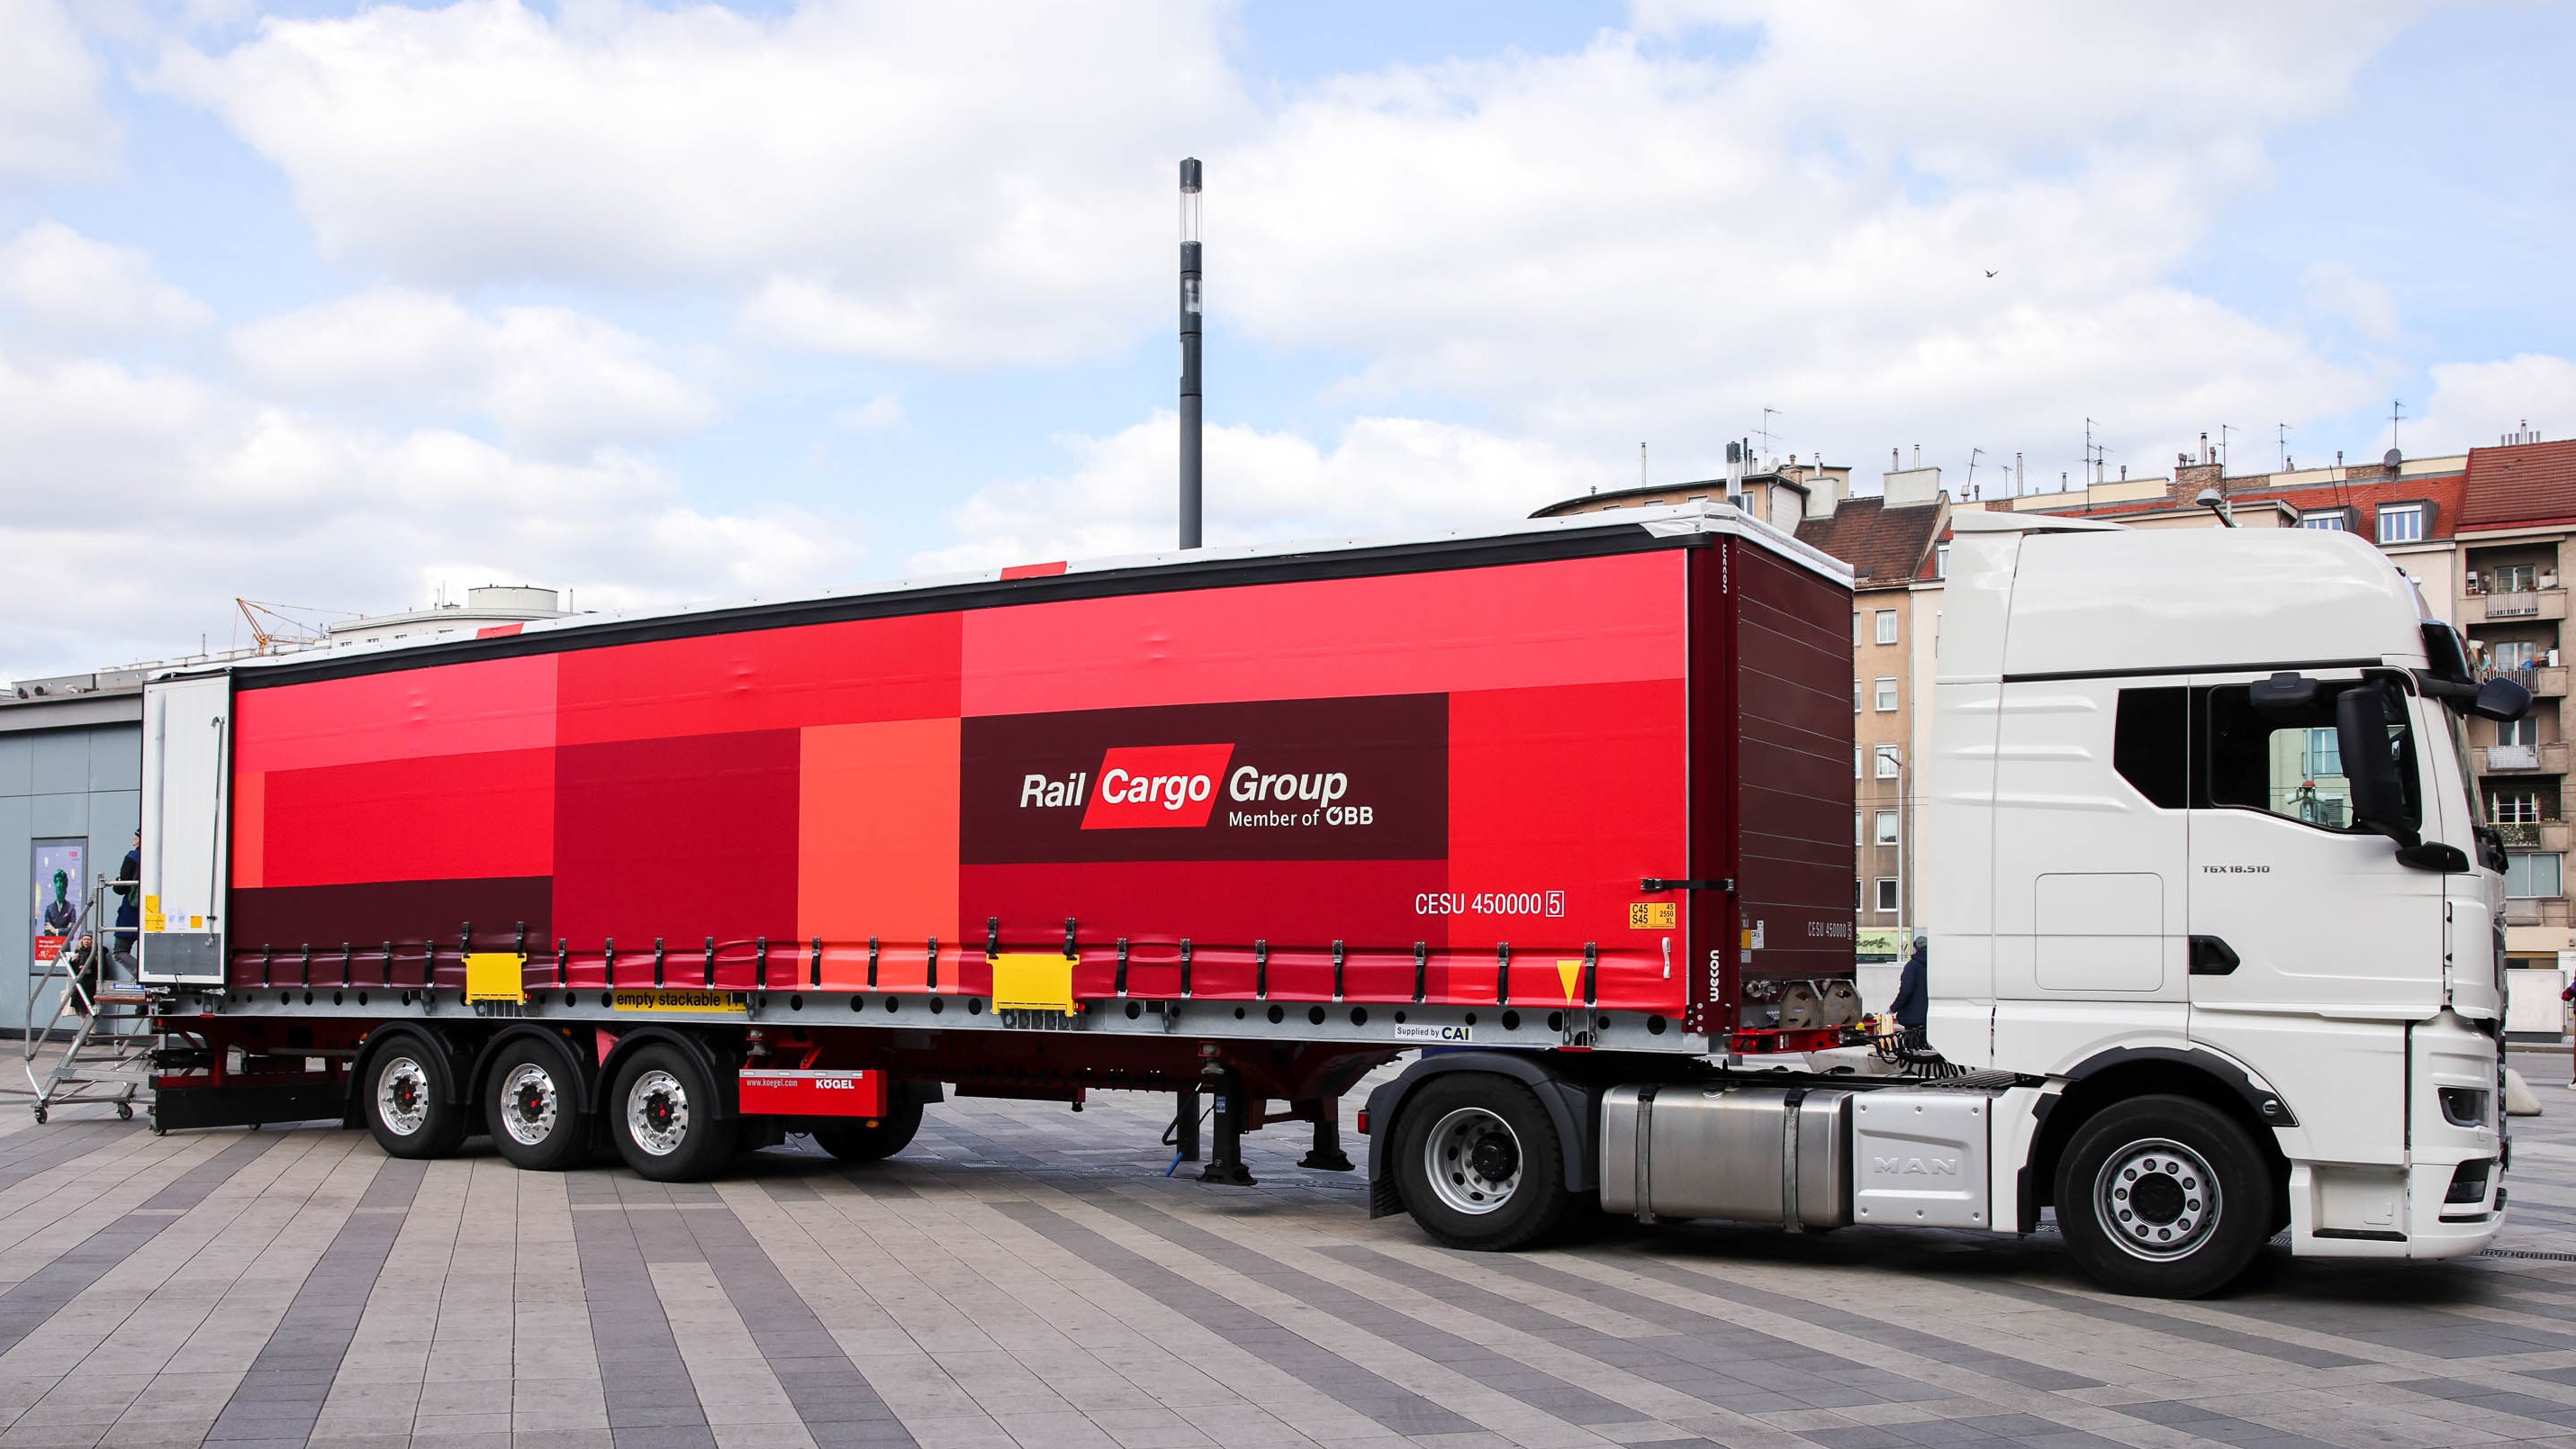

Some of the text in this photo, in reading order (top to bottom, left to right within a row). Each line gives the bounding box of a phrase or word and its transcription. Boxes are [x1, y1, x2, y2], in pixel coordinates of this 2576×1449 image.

[1020, 765, 1348, 810] Rail Cargo Group
[1229, 806, 1374, 827] Member of ÖBB
[2202, 865, 2270, 874] TGX 18.510
[1415, 892, 1561, 916] CESU 450000 5
[1632, 904, 1648, 914] C45
[1632, 914, 1648, 924] S45
[1808, 921, 1824, 937] CESU
[1710, 949, 1720, 1001] wecon
[617, 992, 655, 1008] empty
[658, 992, 720, 1007] stackable
[1397, 1027, 1469, 1041] Supplied by CAI
[746, 1078, 855, 1090] www.koegel.com KÖGEL
[1874, 1156, 1957, 1176] MAN
